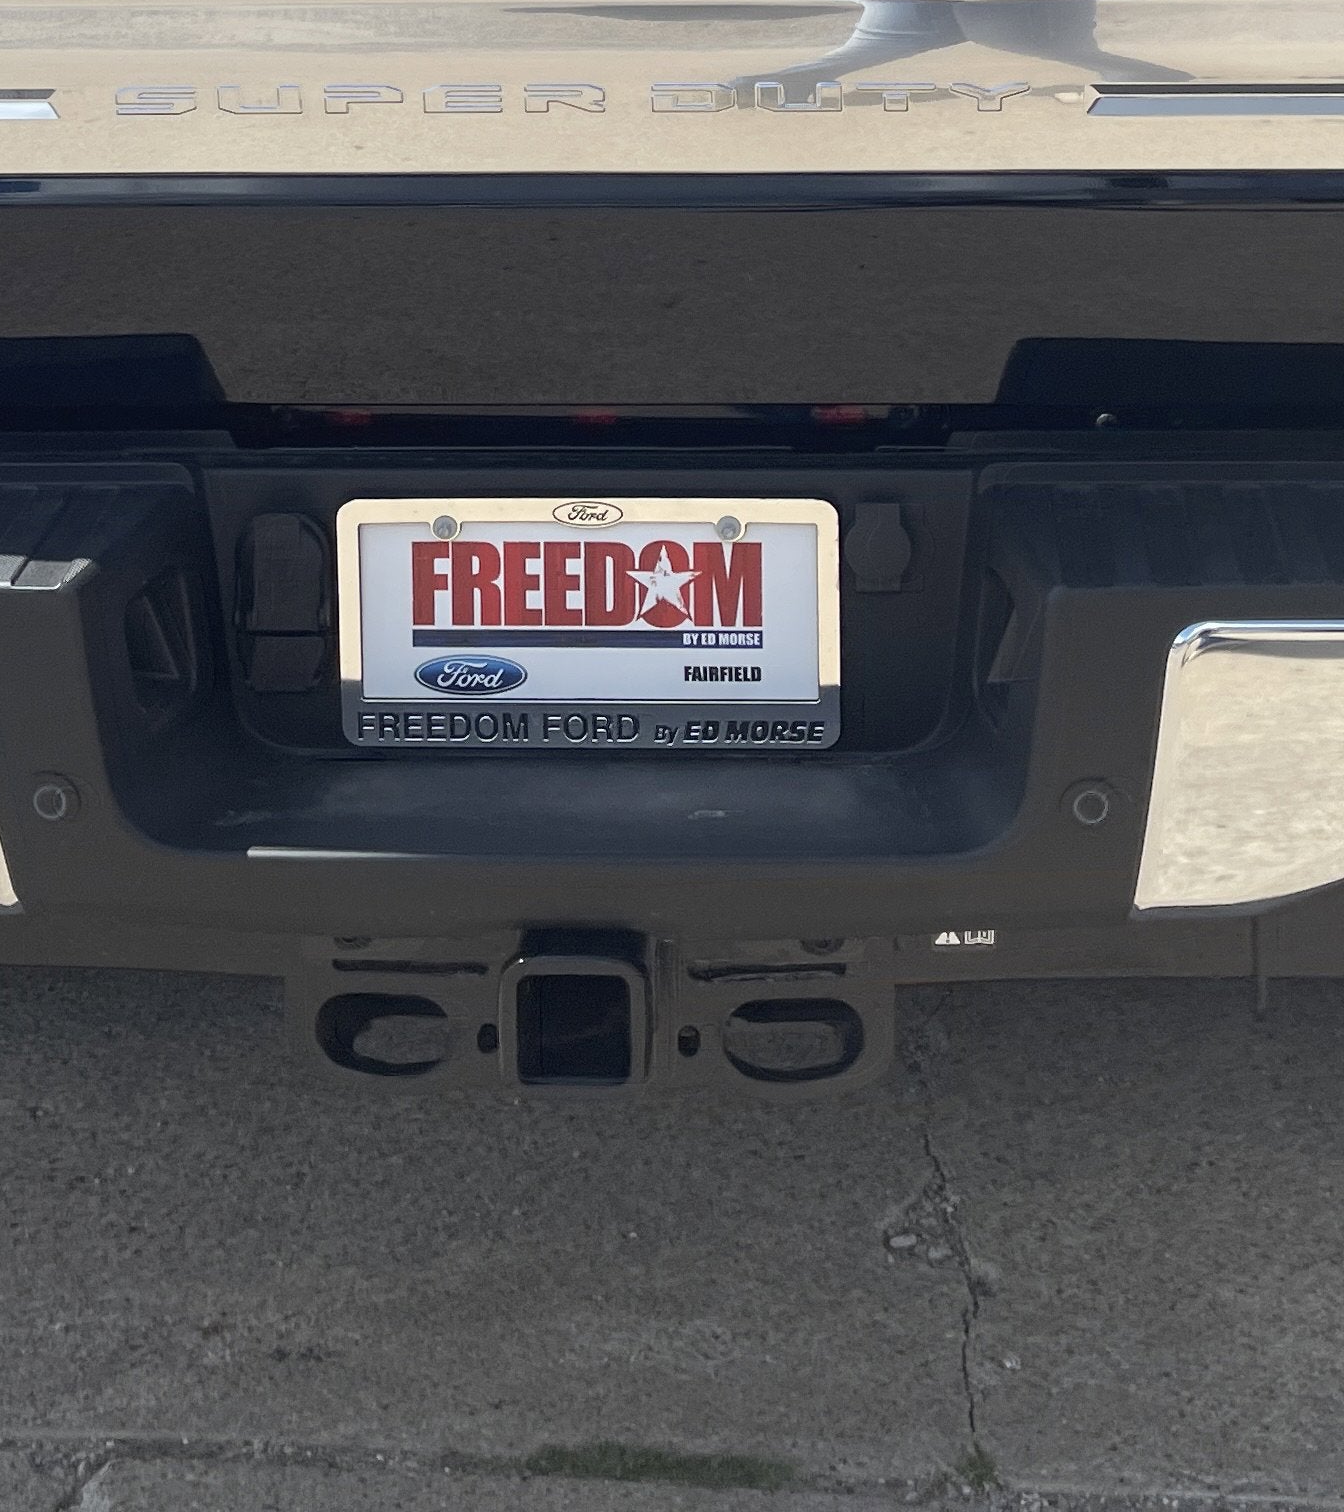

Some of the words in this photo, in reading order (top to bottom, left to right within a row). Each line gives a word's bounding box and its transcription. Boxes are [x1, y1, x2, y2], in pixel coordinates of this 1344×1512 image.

[115, 84, 607, 116] SUPER
[650, 81, 1032, 113] DUTY
[567, 504, 609, 523] Ford
[412, 540, 763, 627] FREEDOM
[683, 633, 699, 646] BY
[701, 633, 716, 646] ED
[718, 633, 761, 646] MORSE
[436, 660, 504, 689] Ford
[684, 665, 762, 683] FAIRFIELD
[357, 712, 529, 743] FREEDOM
[543, 712, 641, 743] FORD
[654, 725, 677, 747] By
[683, 721, 724, 743] ED
[725, 721, 825, 743] MORSE
